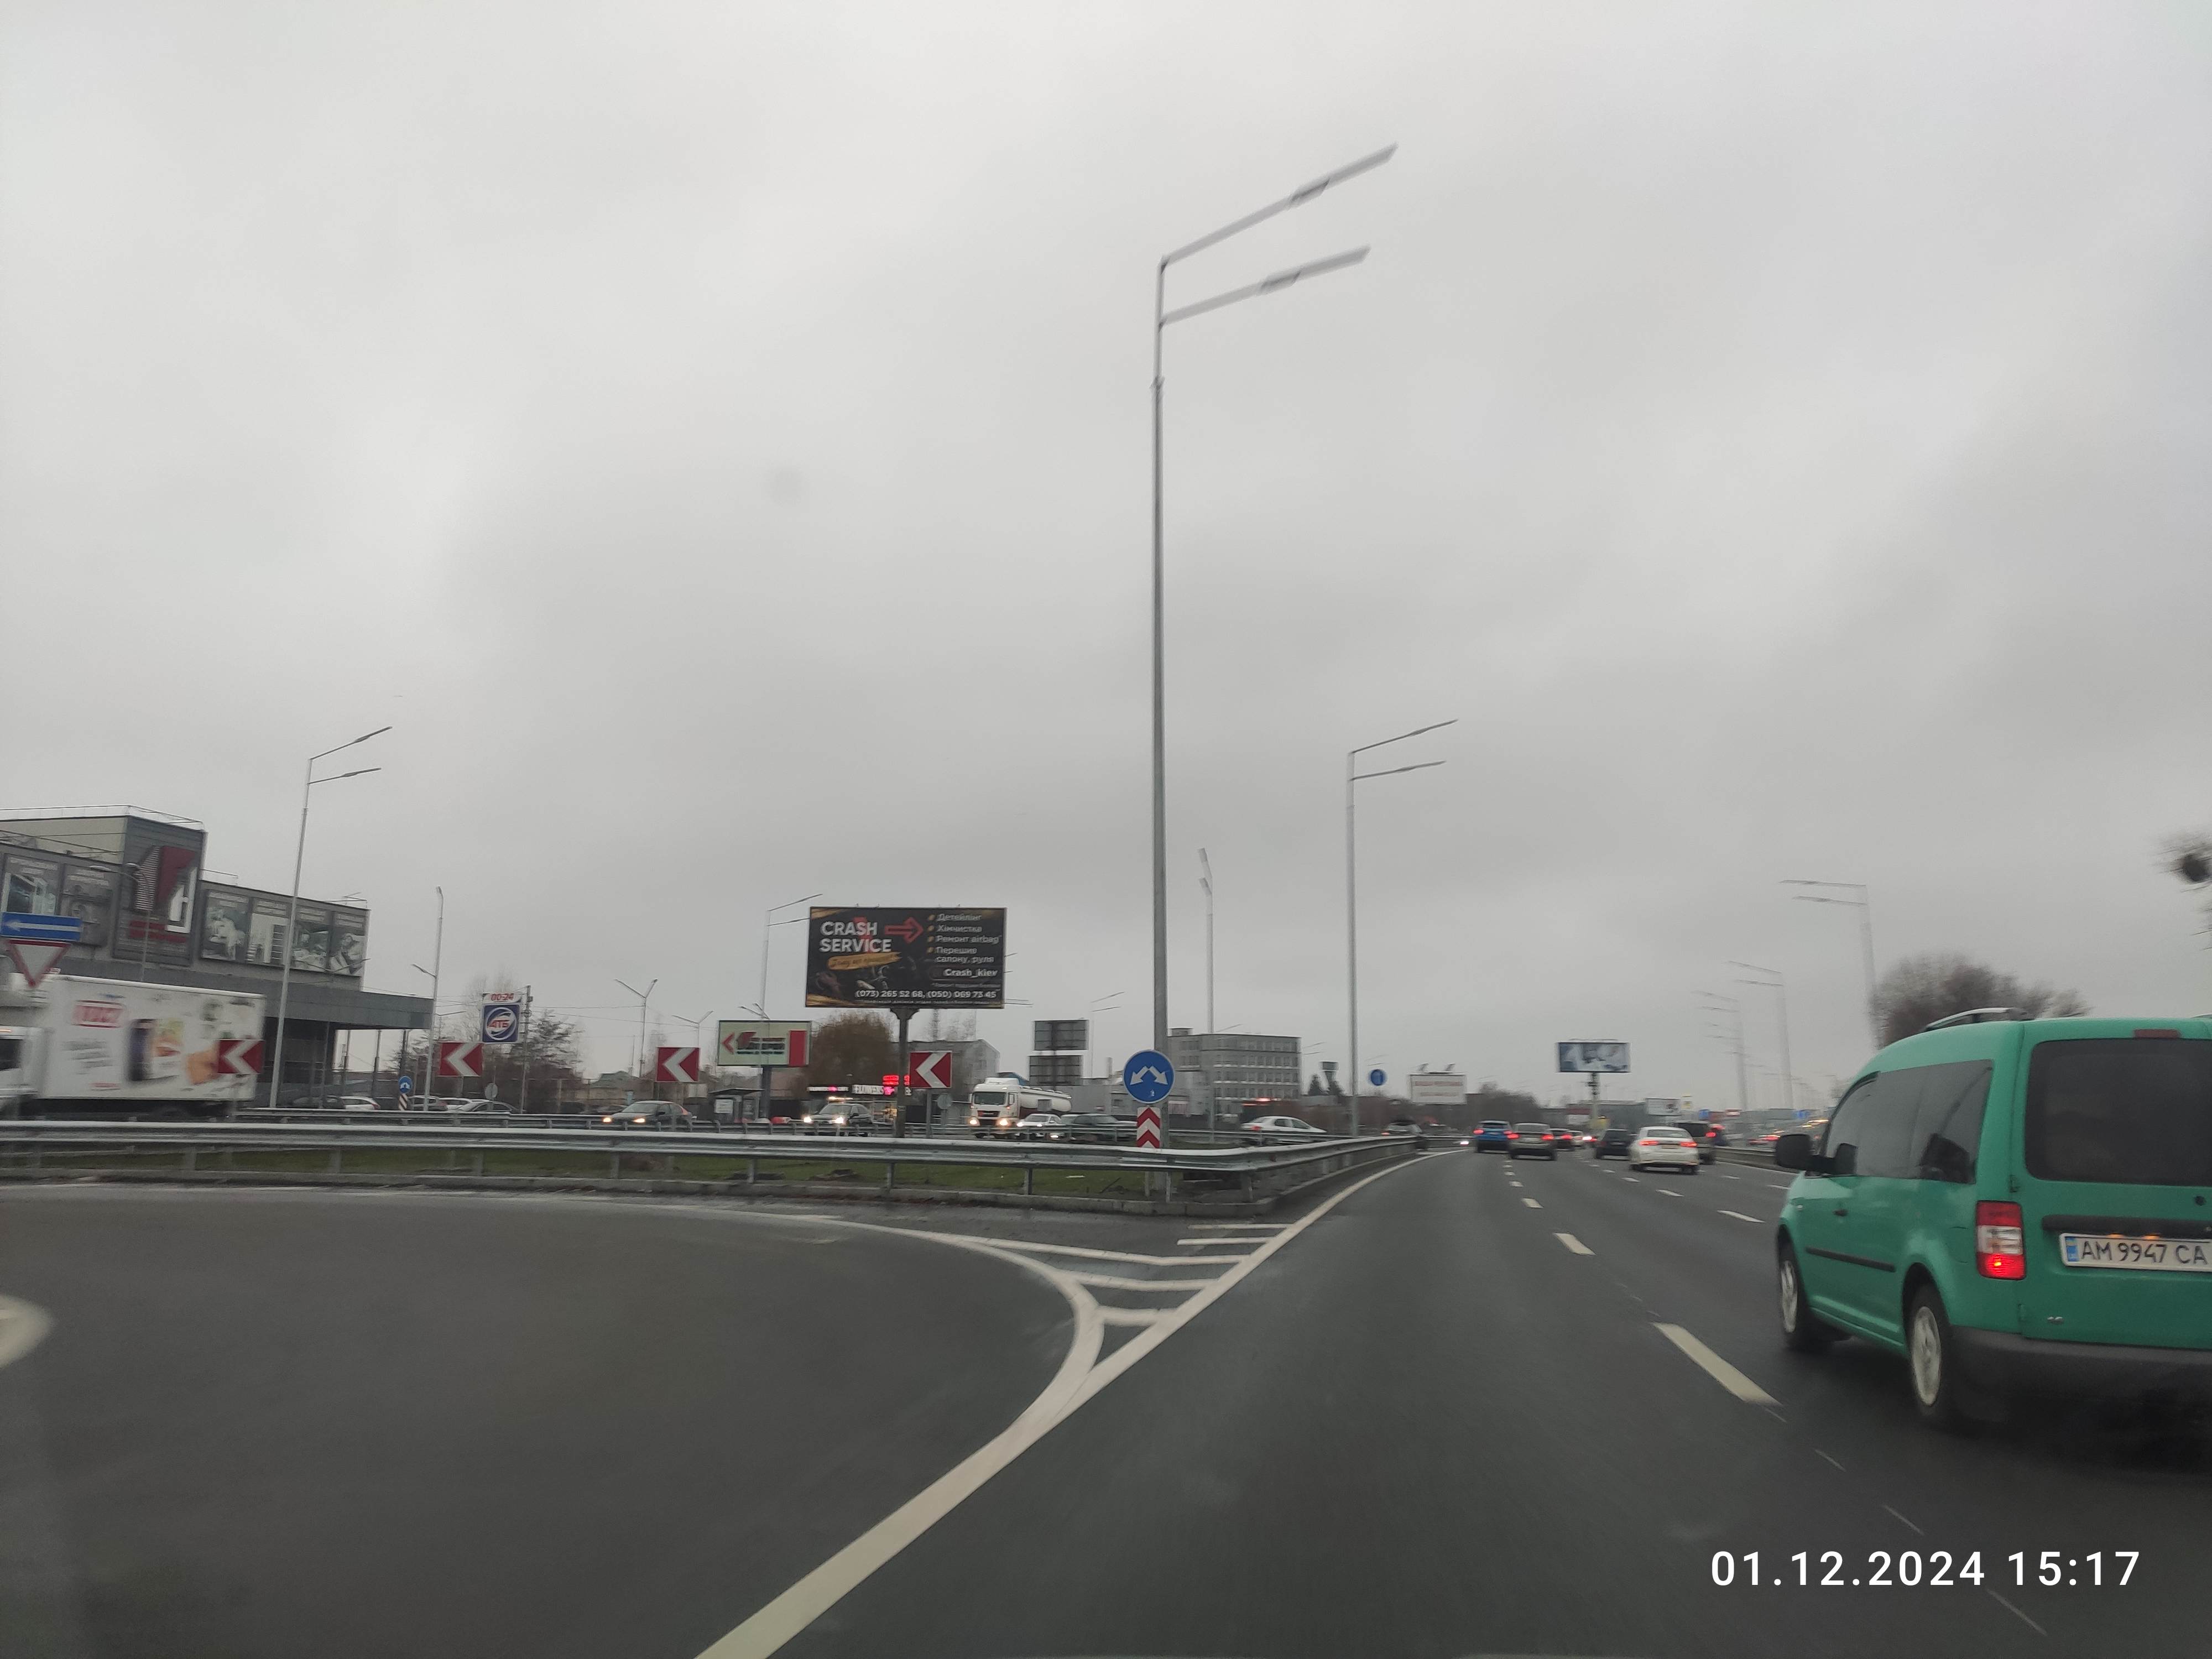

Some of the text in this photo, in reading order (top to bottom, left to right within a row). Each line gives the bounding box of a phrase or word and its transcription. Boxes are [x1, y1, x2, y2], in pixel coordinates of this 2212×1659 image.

[821, 921, 878, 936] CRASH
[819, 938, 892, 952] SERVICE
[2081, 1240, 2208, 1265] AM 9947 CA
